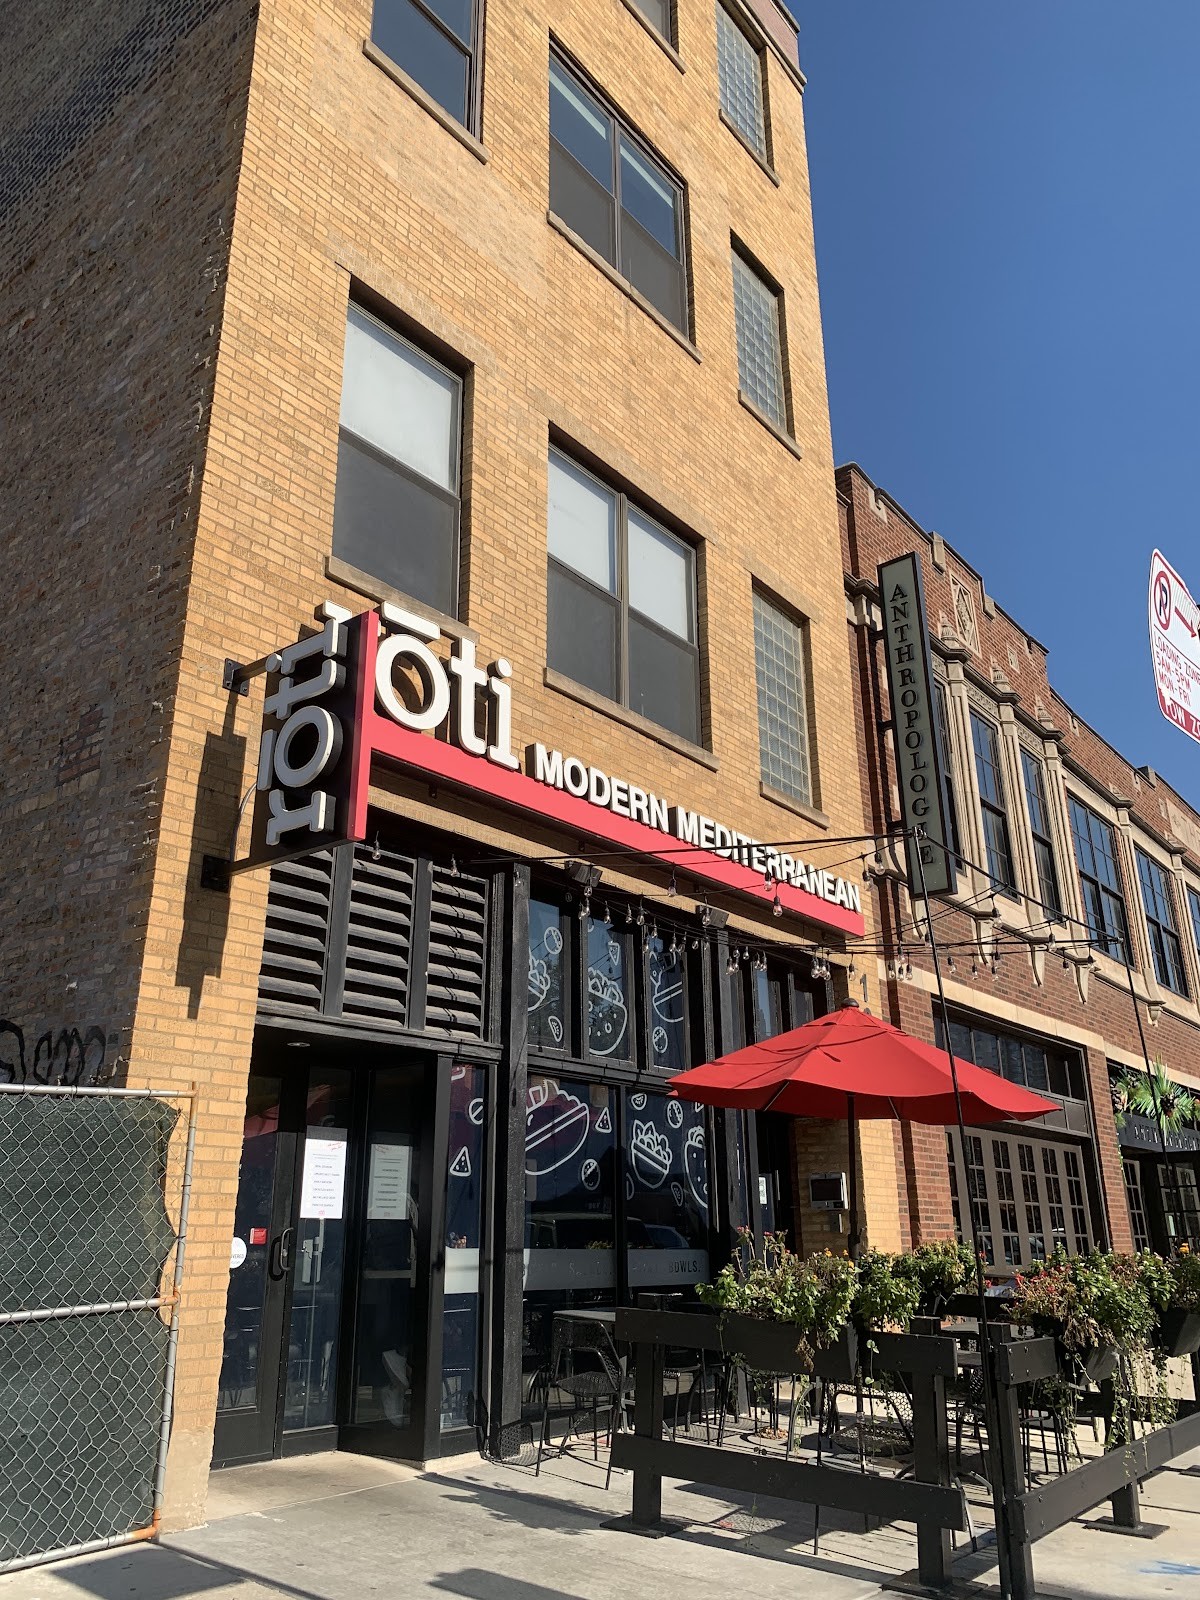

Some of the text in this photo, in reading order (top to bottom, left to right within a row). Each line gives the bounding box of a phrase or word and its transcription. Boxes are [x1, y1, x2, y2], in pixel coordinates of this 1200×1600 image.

[324, 600, 520, 770] ōti
[1153, 631, 1182, 670] LOADING
[535, 742, 862, 914] MODERN MEDITERRANEAN
